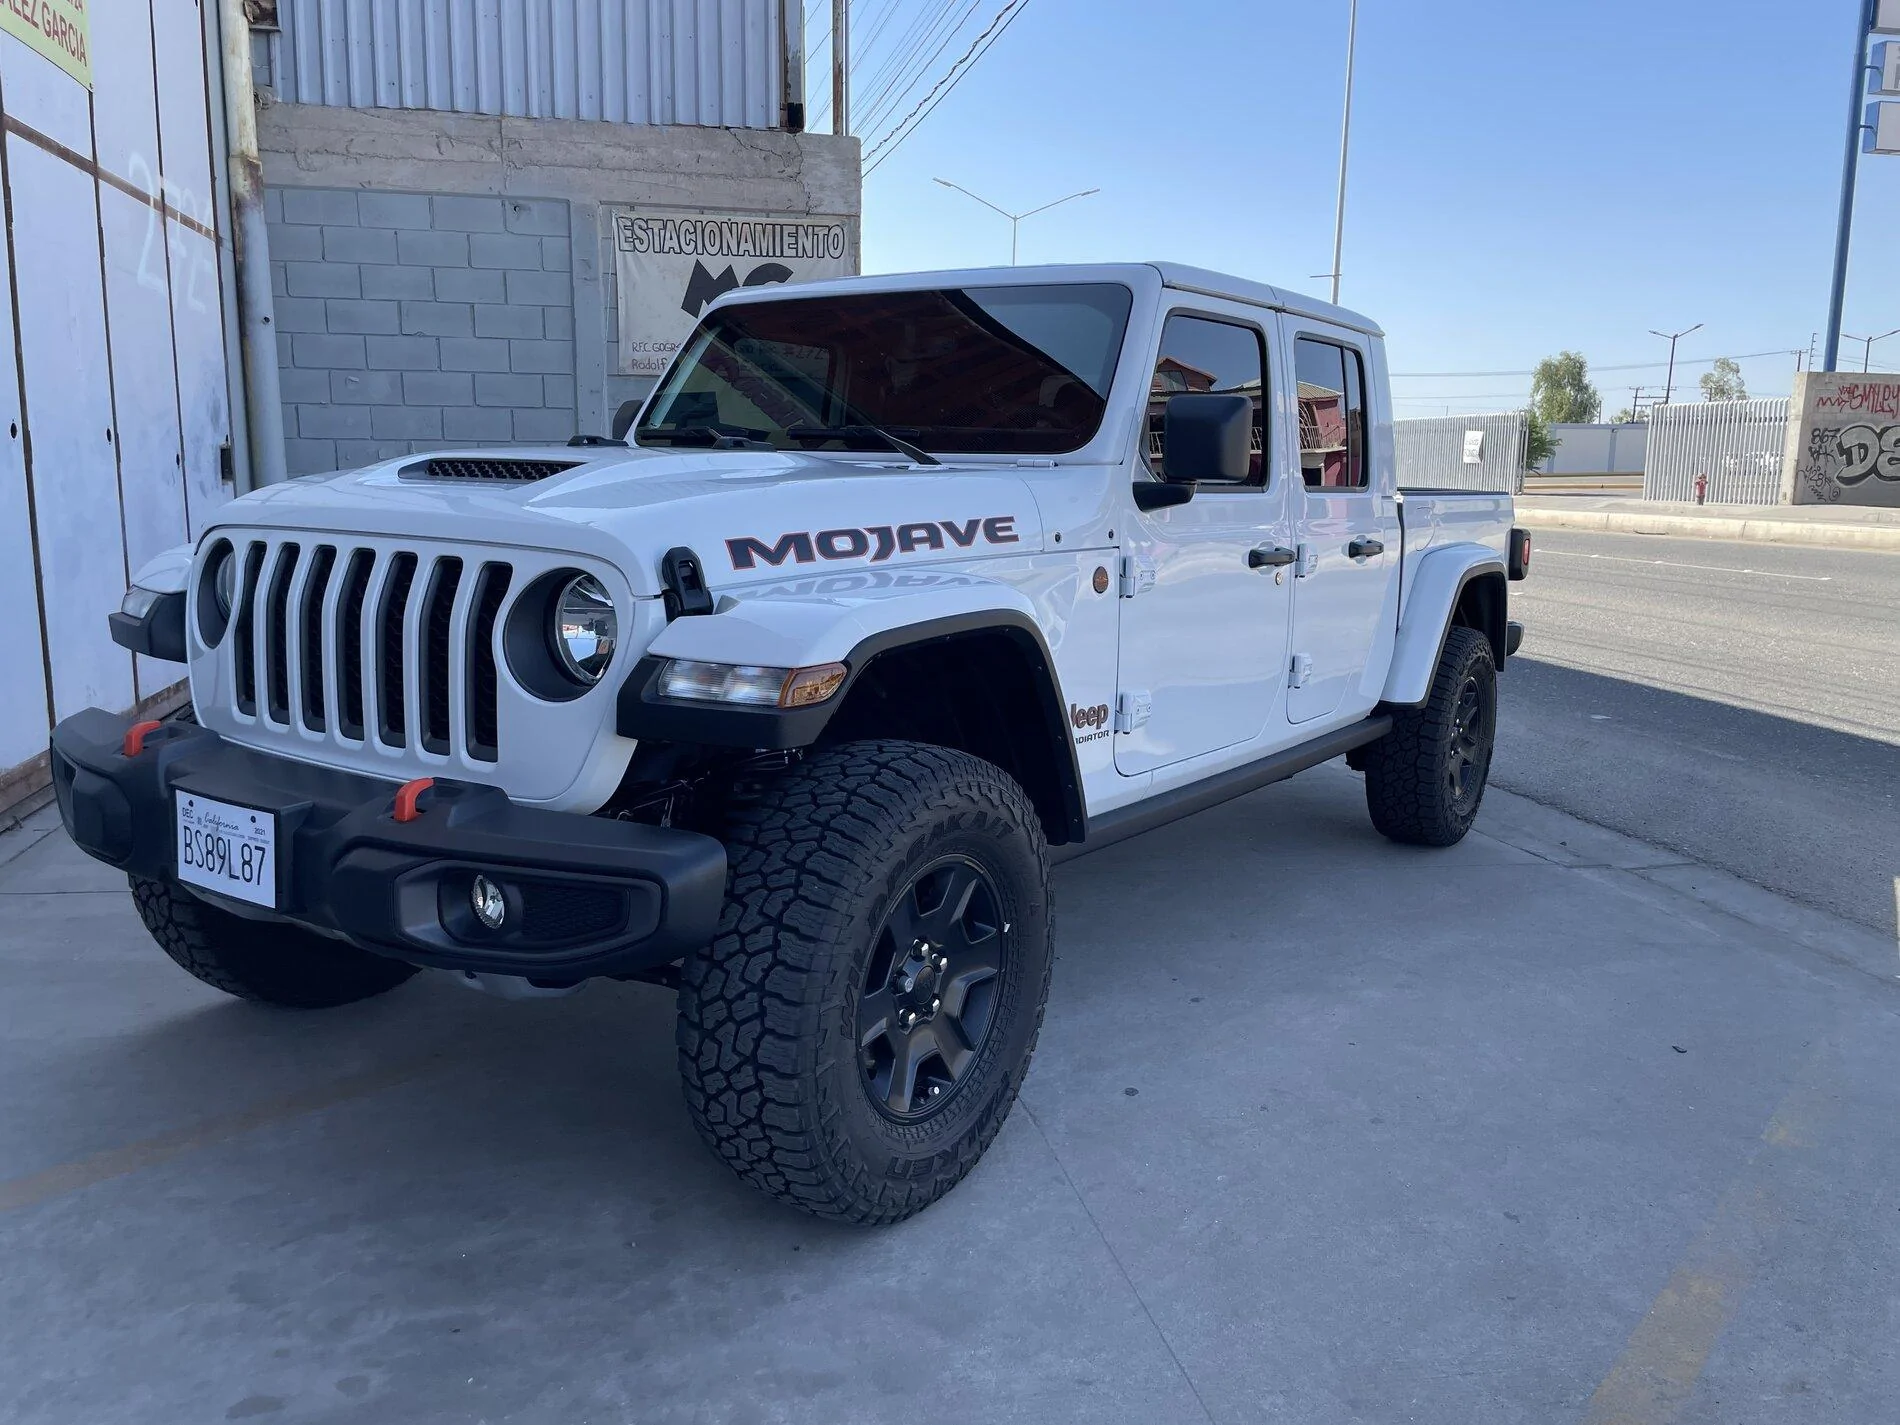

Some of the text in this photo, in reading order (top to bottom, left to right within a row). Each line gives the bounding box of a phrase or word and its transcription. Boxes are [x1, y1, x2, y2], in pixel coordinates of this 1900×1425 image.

[41, 1, 87, 67] GARCIA
[616, 216, 847, 259] ESTACIONAMIENTO
[724, 515, 1020, 571] MOJAVE
[182, 807, 194, 819] DEC
[205, 812, 240, 832] California
[183, 825, 266, 886] BS89L87
